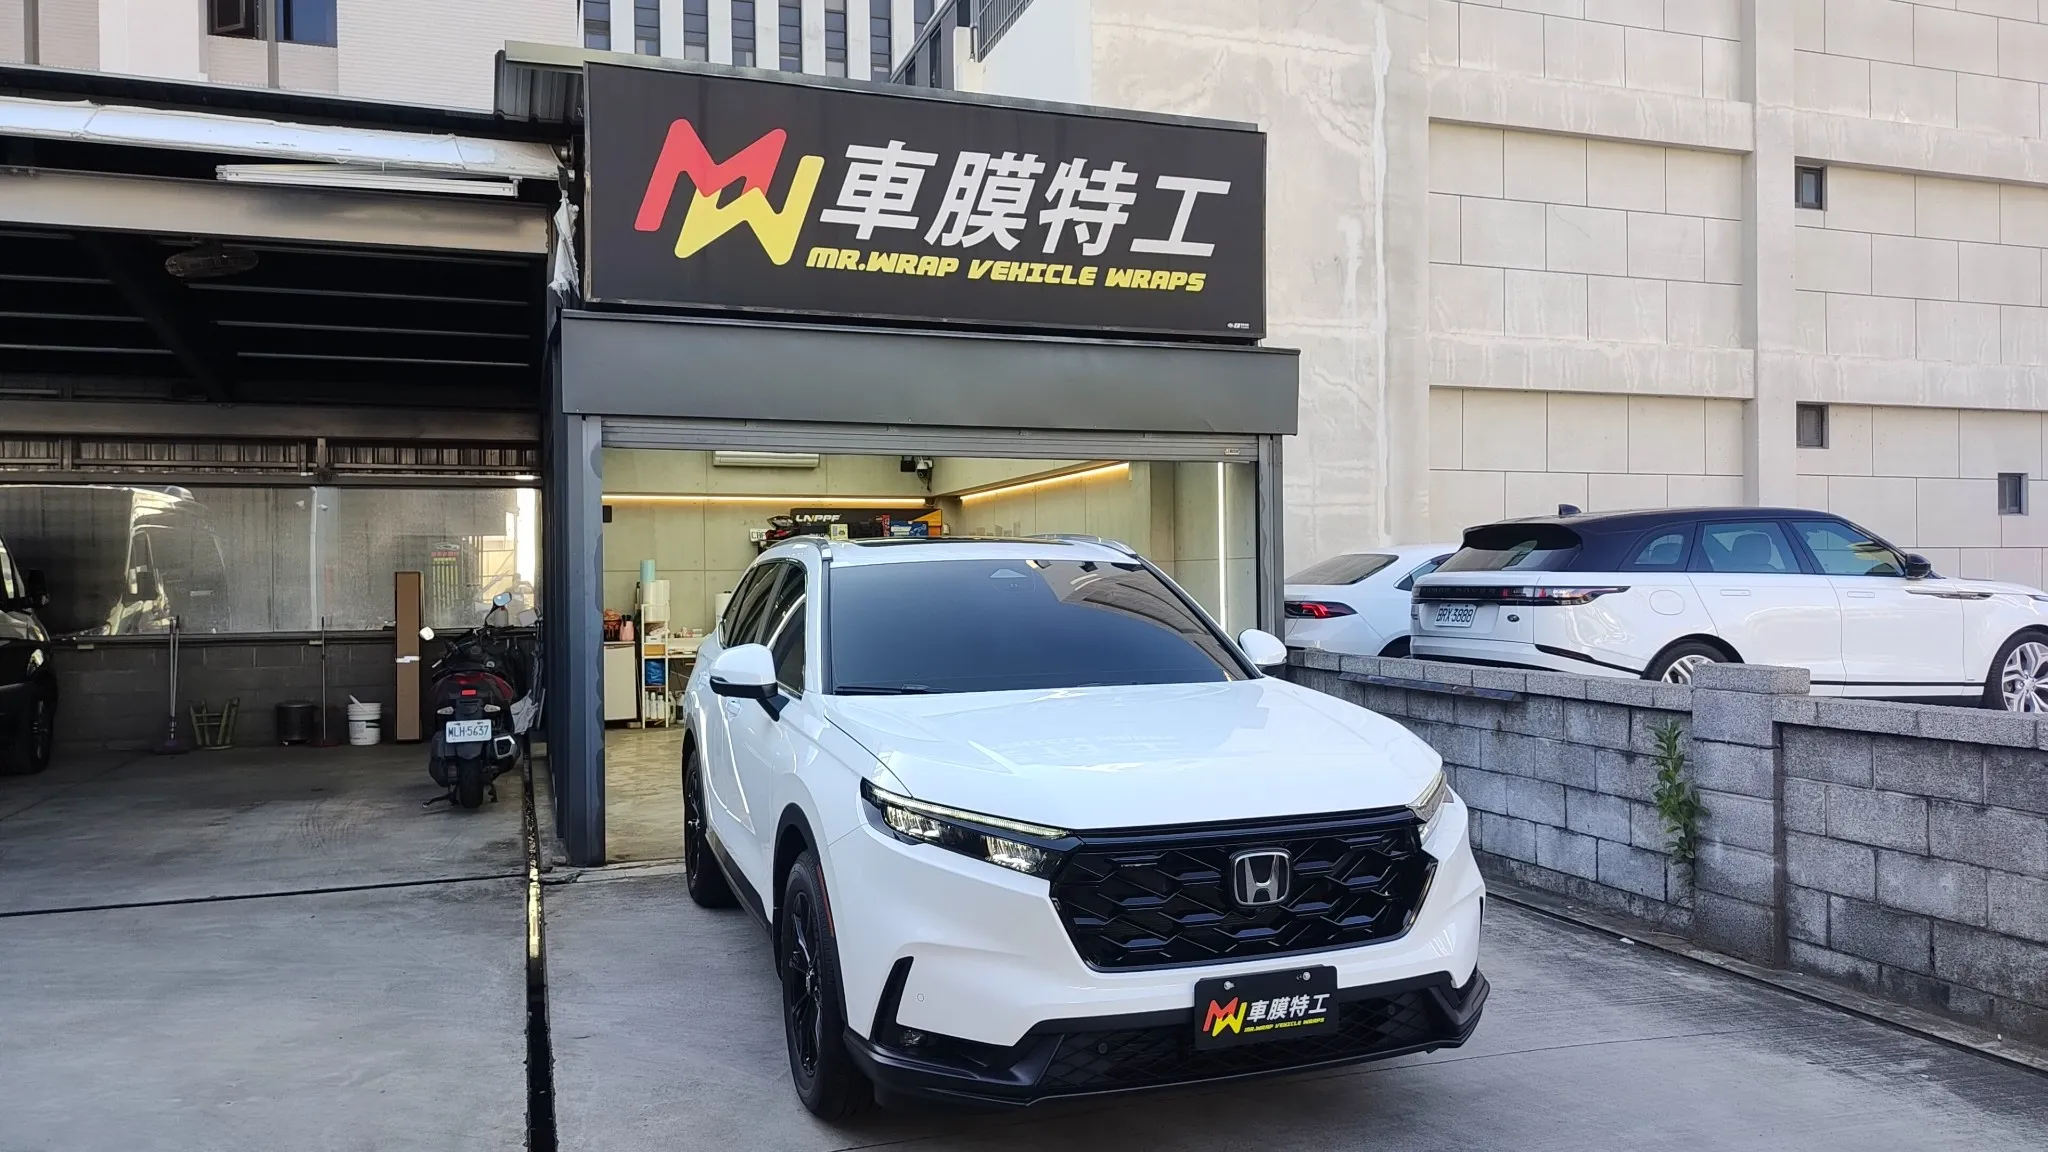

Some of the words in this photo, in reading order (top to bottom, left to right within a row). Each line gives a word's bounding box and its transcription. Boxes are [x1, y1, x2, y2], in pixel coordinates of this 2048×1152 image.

[820, 139, 1231, 257] 車膜特工
[807, 246, 959, 277] MR.WRAP
[968, 258, 1098, 287] VEHICLE
[1104, 268, 1206, 292] WRAPS
[1247, 994, 1330, 1023] 車膜特工
